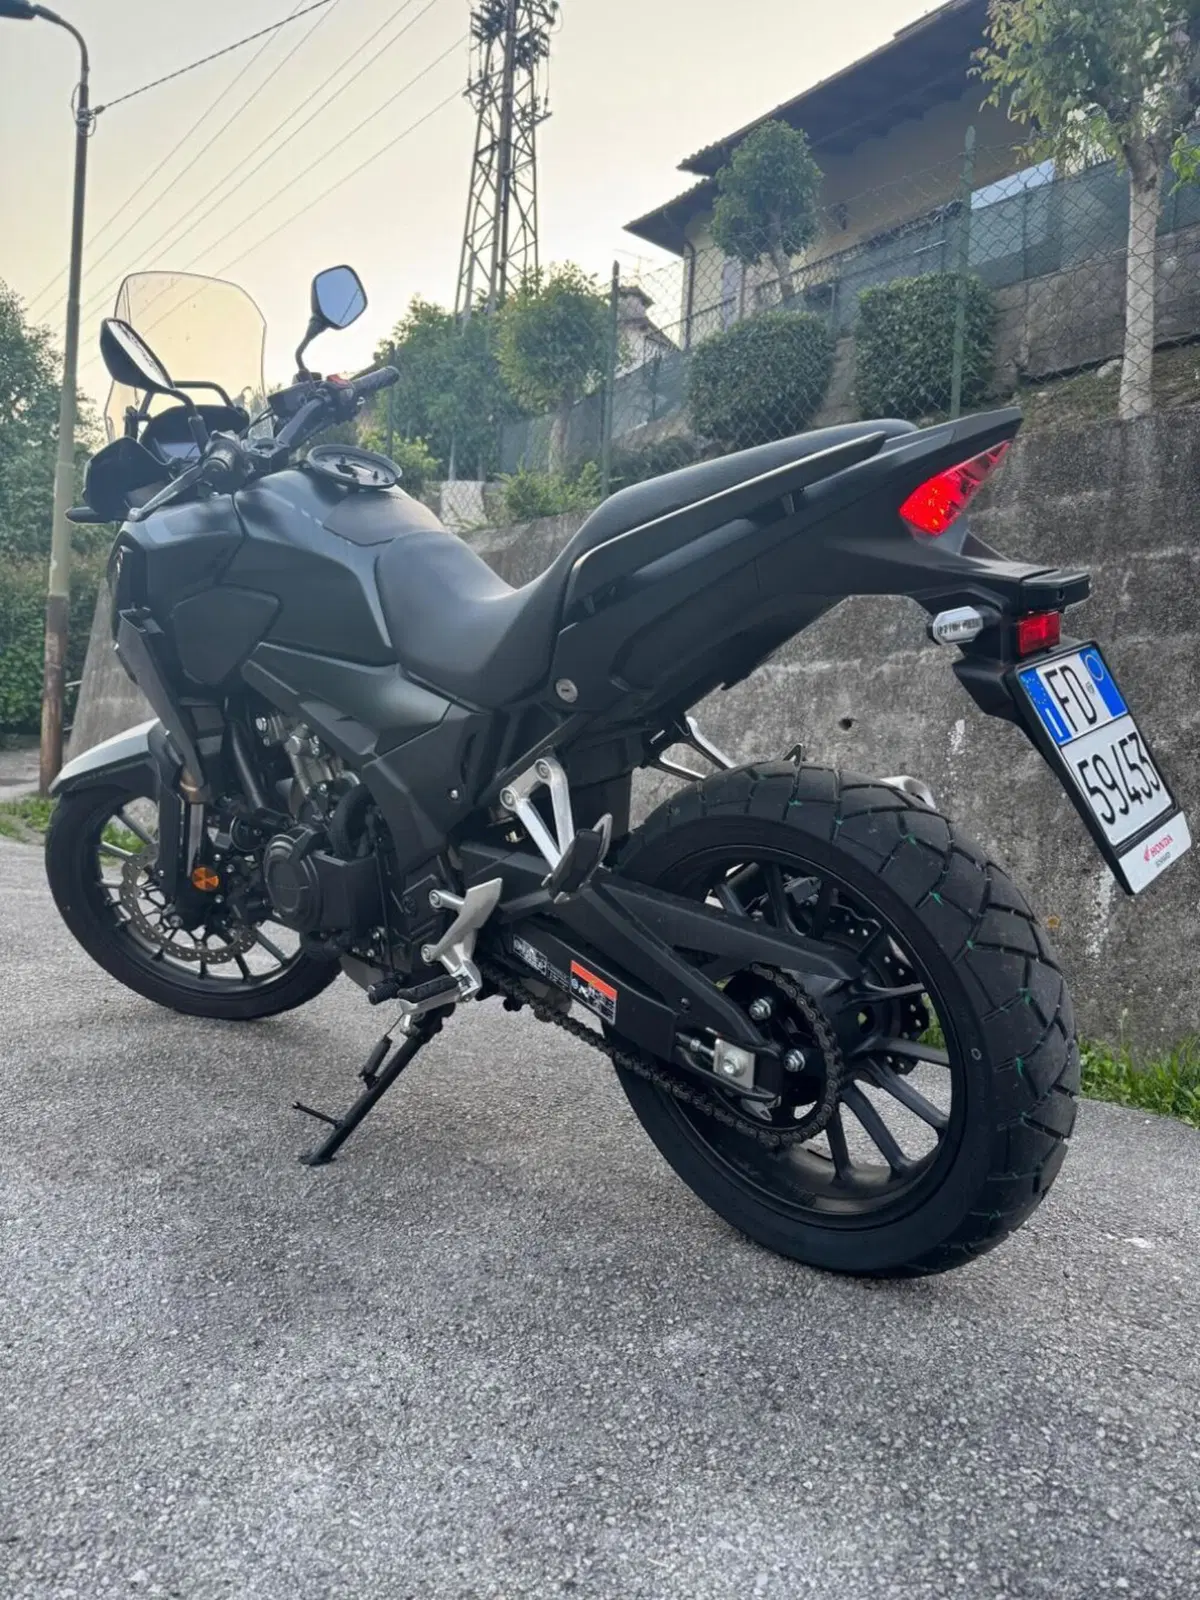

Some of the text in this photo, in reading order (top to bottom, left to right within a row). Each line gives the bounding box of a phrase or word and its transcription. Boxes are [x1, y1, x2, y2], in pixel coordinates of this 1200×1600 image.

[1044, 665, 1097, 732] FD
[1077, 732, 1161, 825] 59453
[1150, 834, 1173, 857] HONDA
